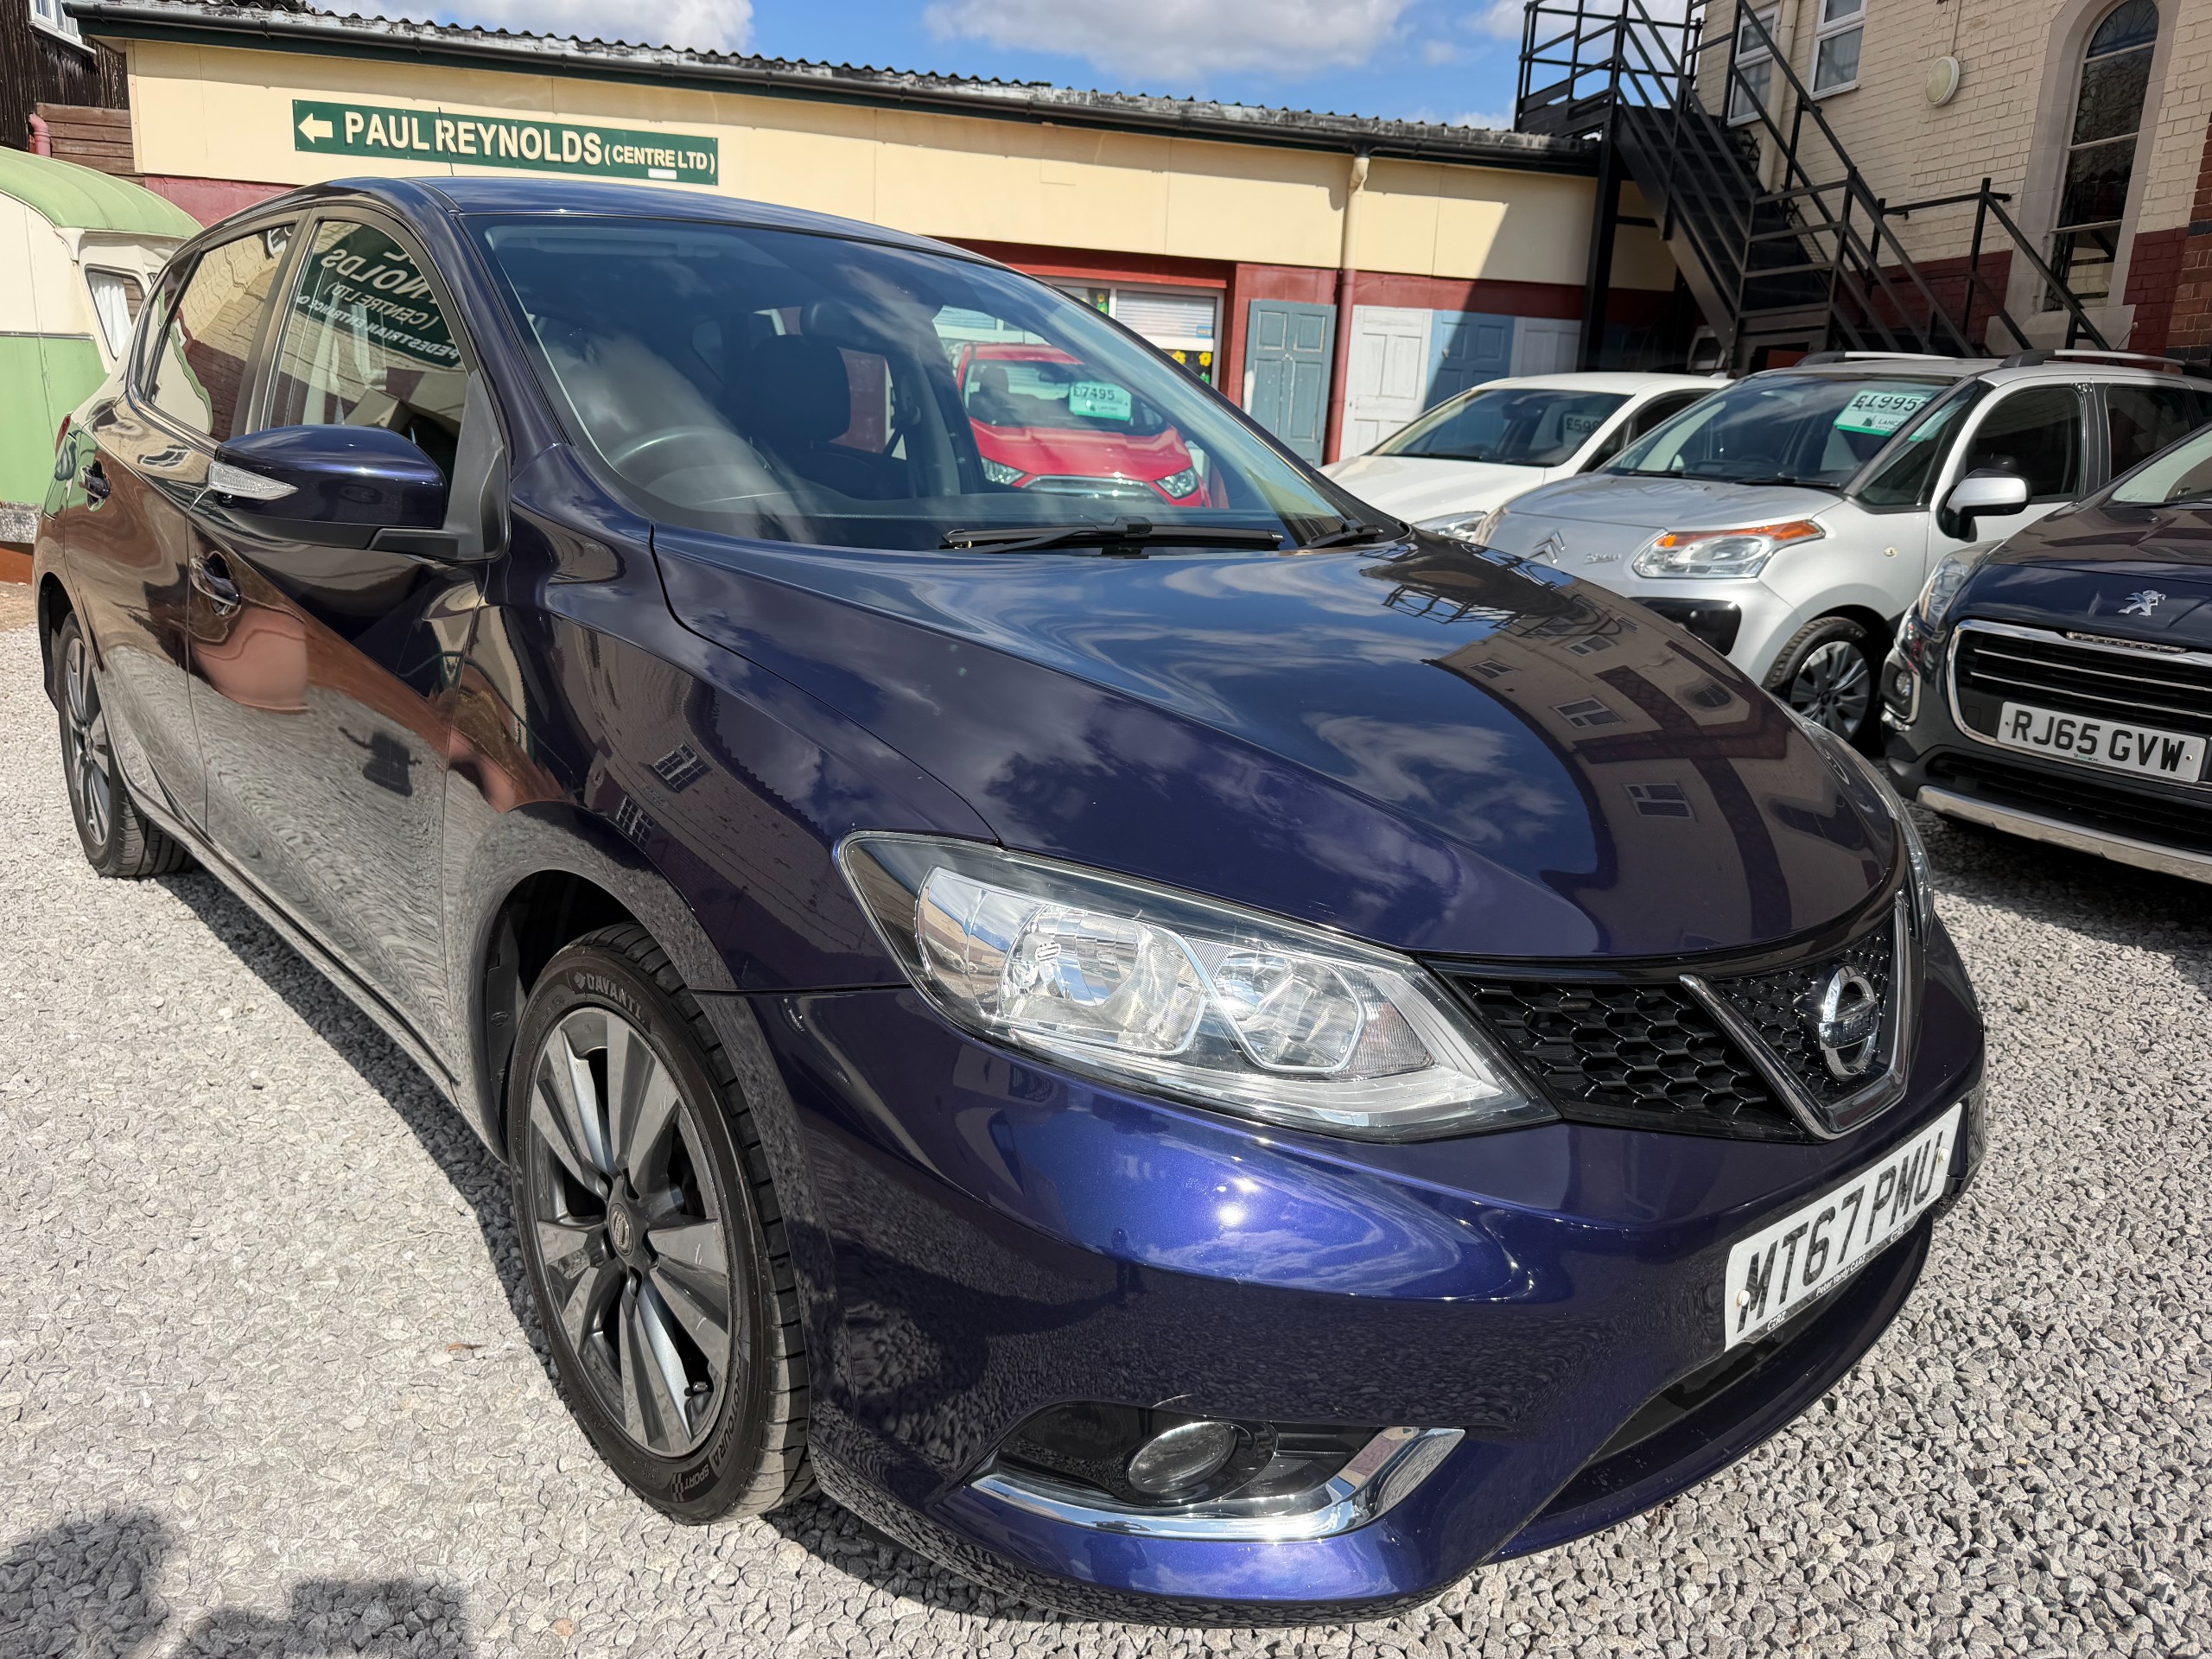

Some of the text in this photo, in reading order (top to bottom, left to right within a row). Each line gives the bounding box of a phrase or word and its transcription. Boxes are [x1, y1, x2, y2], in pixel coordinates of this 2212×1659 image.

[345, 111, 715, 175] PAUL REYNOLDS (CENTRE LTD)
[1073, 385, 1116, 401] £7495
[1852, 395, 1920, 412] £1995
[2011, 709, 2186, 772] RJ65 GVW
[586, 972, 642, 1020] DAVANTI
[1736, 1185, 1866, 1334] MT67
[1815, 1253, 1867, 1297] Peter Vardy CARZ
[683, 1464, 710, 1490] SPORT
